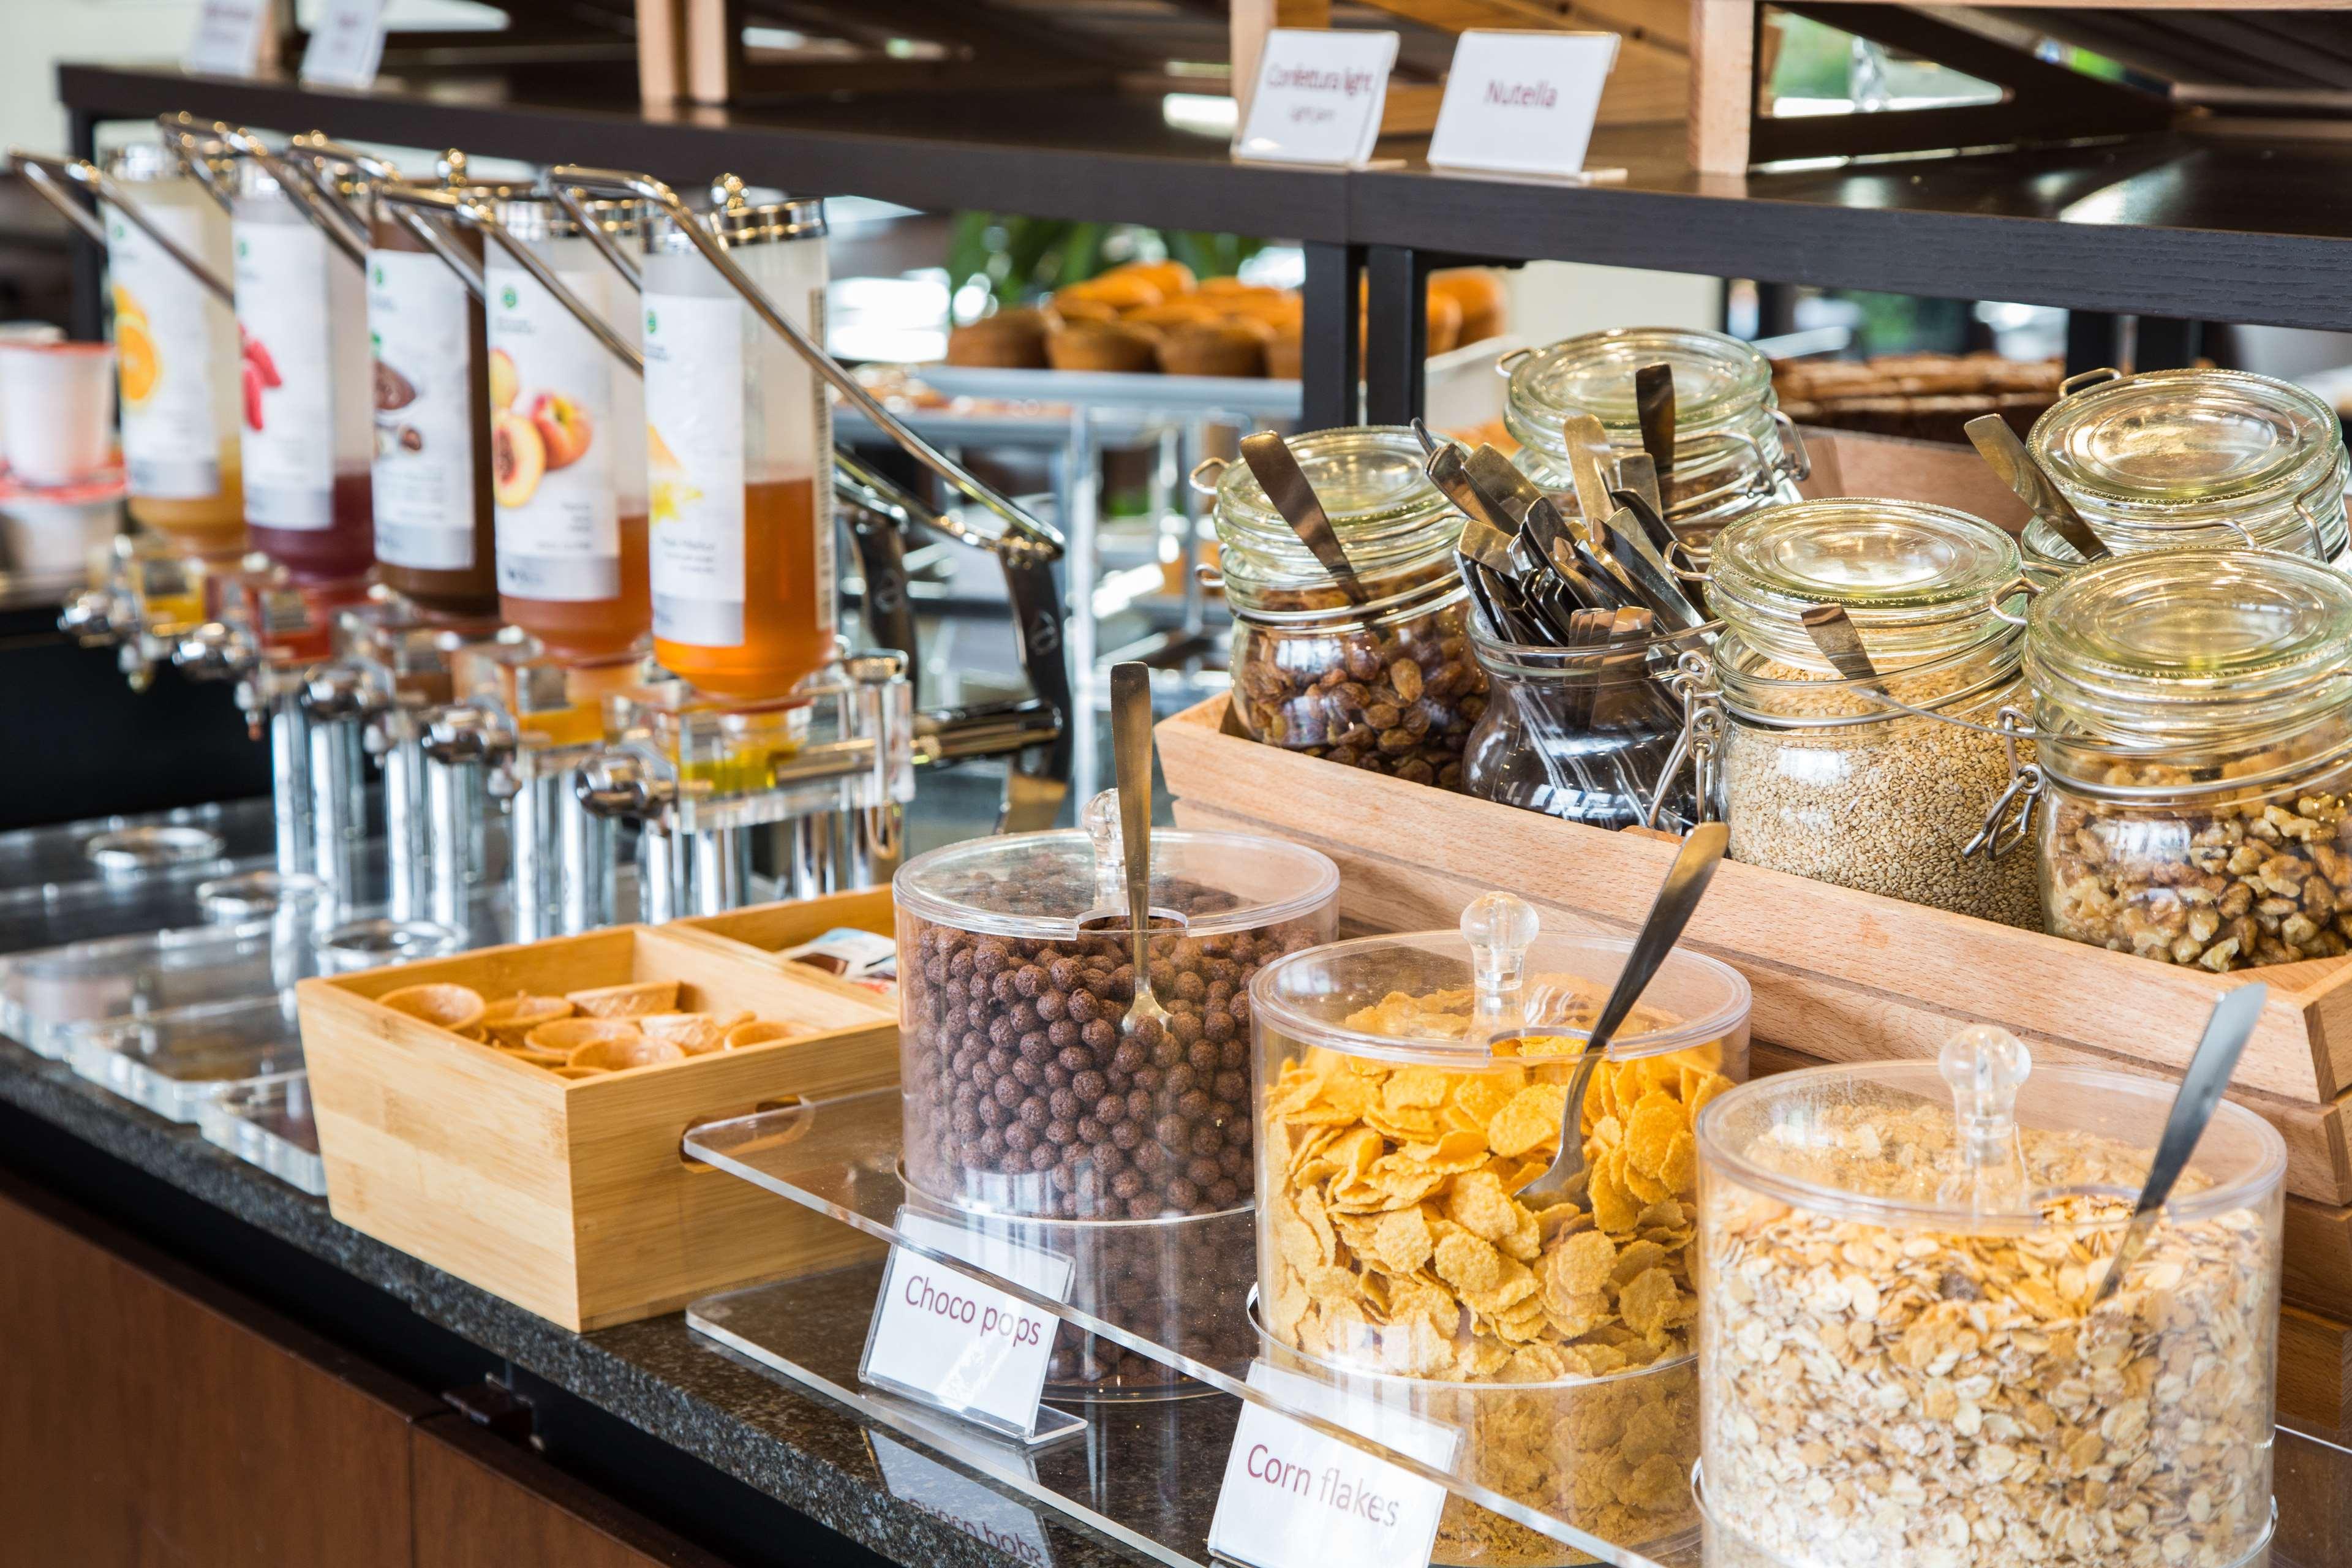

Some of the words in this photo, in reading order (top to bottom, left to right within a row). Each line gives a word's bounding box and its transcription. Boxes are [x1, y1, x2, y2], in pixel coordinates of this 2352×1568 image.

[1485, 80, 1558, 108] Nutella
[905, 1275, 976, 1324] Choco
[981, 1305, 1041, 1348] pops
[1247, 1444, 1312, 1496] Corn
[1319, 1467, 1400, 1528] flakes
